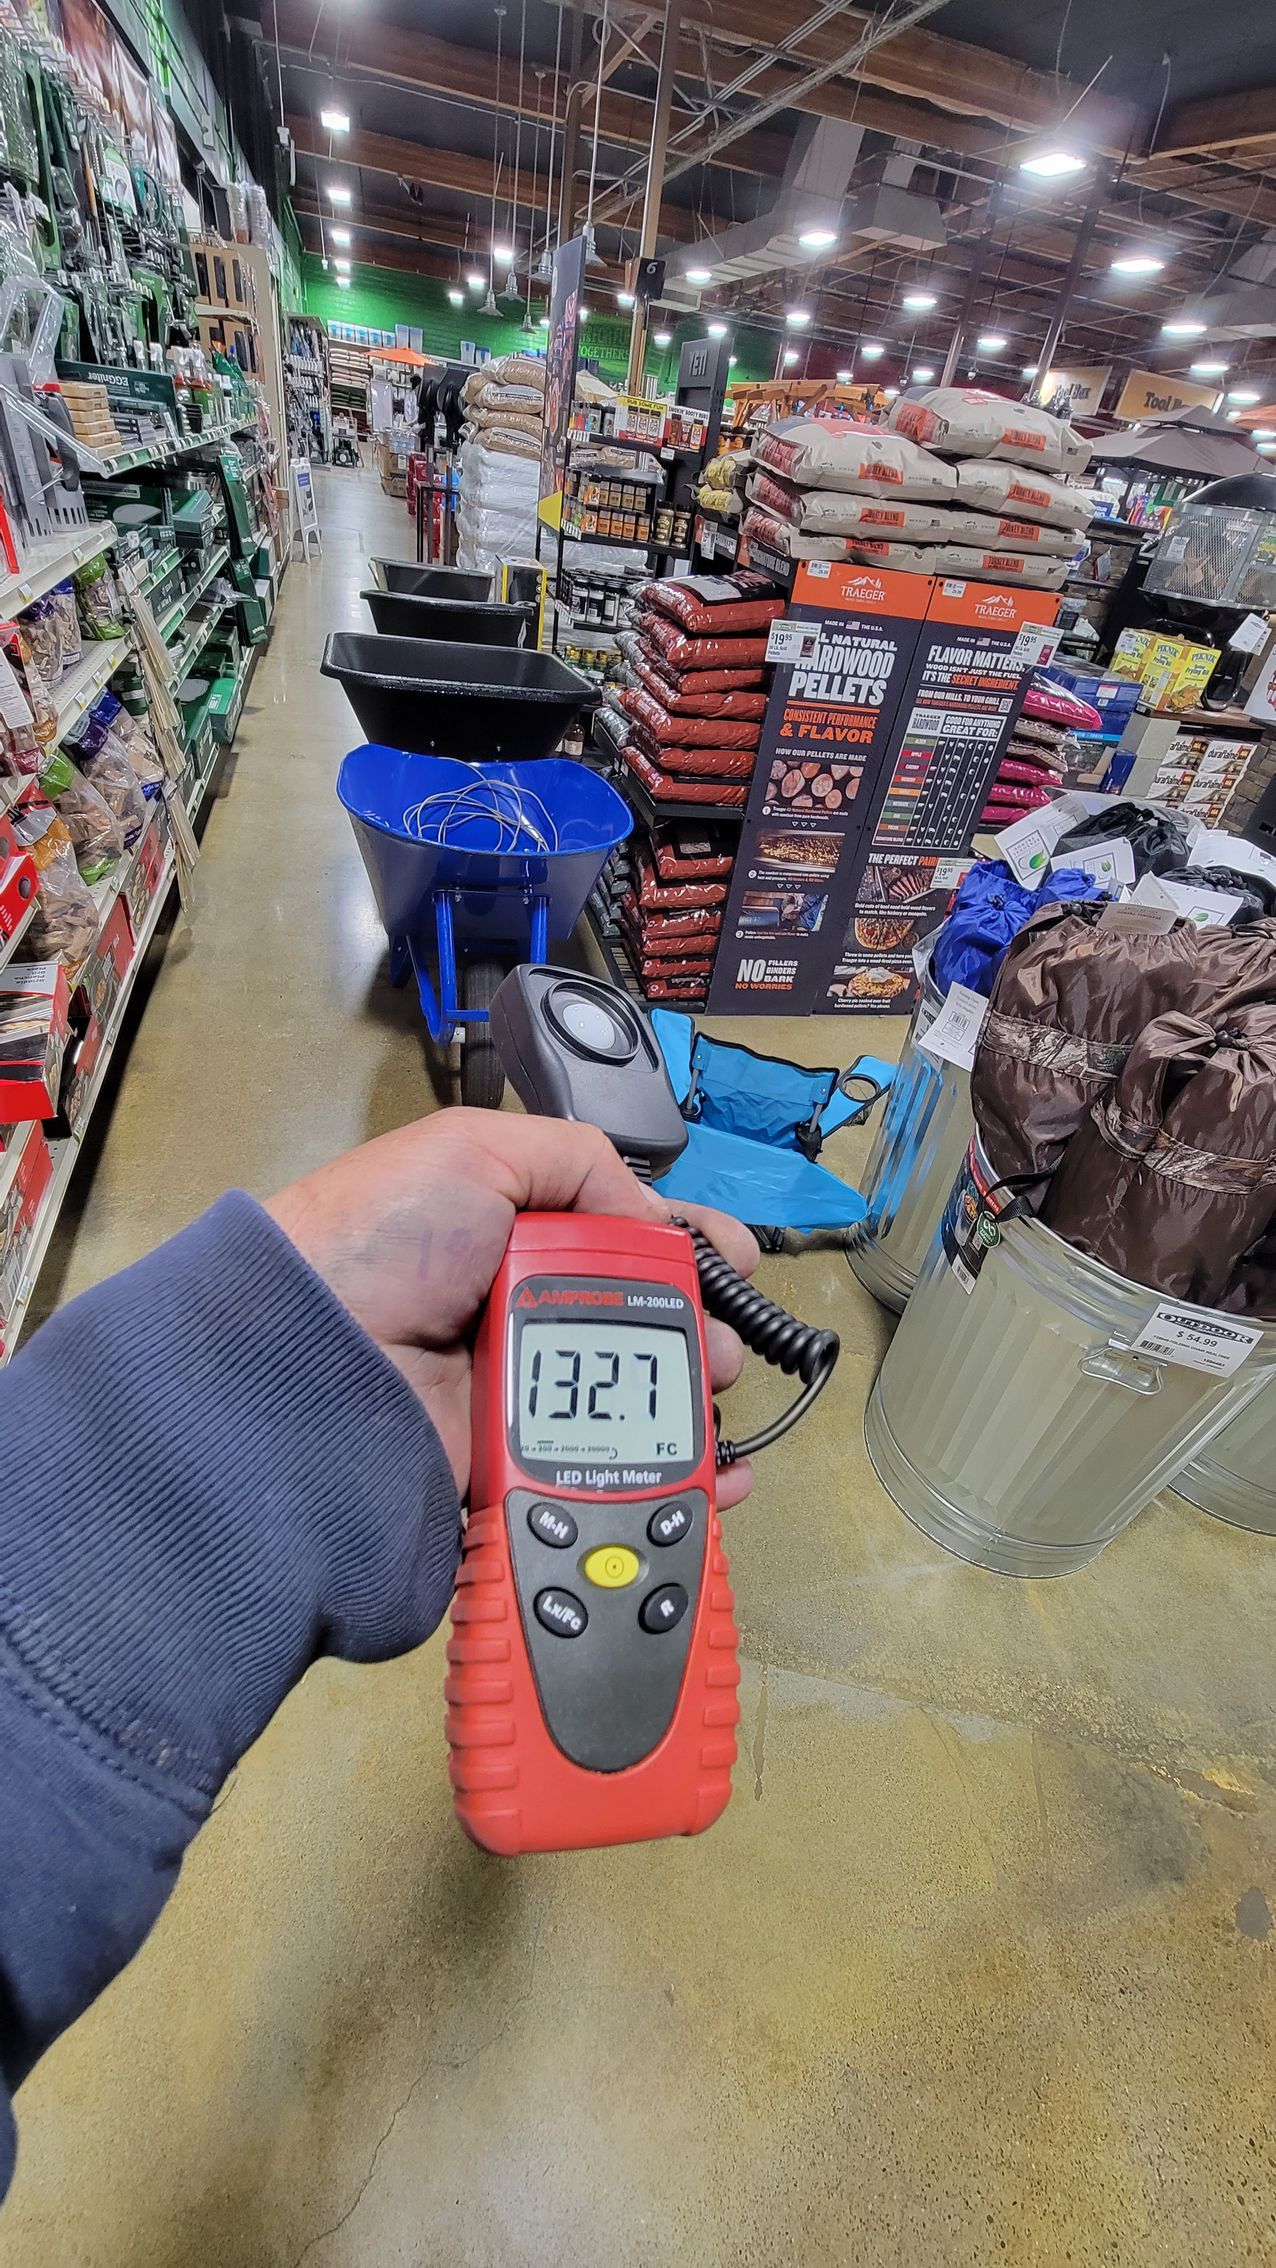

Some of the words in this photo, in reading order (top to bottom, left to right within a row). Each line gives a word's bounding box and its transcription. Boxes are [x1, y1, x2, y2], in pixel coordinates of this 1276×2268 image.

[646, 261, 658, 275] 6
[689, 349, 708, 377] YETI
[87, 371, 129, 387] EGGniter
[1144, 391, 1173, 411] Tool
[841, 585, 886, 601] TRAEGER
[974, 603, 1016, 619] TRAEGER
[831, 634, 898, 652] NATURAL
[927, 645, 973, 667] FLAVOR
[971, 650, 1026, 673] MATTERS.
[1191, 651, 1217, 664] PIKNIK
[922, 670, 937, 682] IT'S
[937, 672, 952, 684] THE
[950, 674, 979, 687] SECRET
[926, 663, 949, 672] WOOD
[949, 664, 968, 674] ISN'T
[968, 667, 988, 676] JUST
[988, 669, 1003, 678] THE
[788, 670, 888, 706] PELLETS
[917, 689, 934, 699] FROM
[933, 690, 946, 700] OUR
[963, 693, 971, 703] TO
[971, 694, 986, 704] YOUR
[984, 696, 1001, 706] GRILL
[783, 708, 829, 725] CONSISTENT
[827, 713, 878, 729] PERFORMANCE
[945, 716, 963, 725] GOOD
[961, 717, 974, 726] FOR
[973, 718, 1001, 729] ANYTHING
[780, 722, 794, 738] &
[798, 724, 874, 744] FLAVOR
[942, 724, 976, 736] GREAT
[975, 727, 998, 738] FOR:
[775, 747, 791, 756] HOW
[791, 748, 806, 757] OUR
[806, 750, 834, 760] PELLETS
[834, 752, 848, 760] ARE
[847, 753, 867, 762] MADE
[1207, 748, 1239, 760] duraflame
[1192, 778, 1223, 789] duraflame
[868, 852, 885, 864] THE
[883, 853, 919, 866] PERFECT
[918, 855, 938, 867] PAIR
[736, 958, 766, 984] NO
[765, 966, 797, 975] BINDERS
[767, 959, 799, 967] FILLERS
[748, 983, 793, 991] WORRIES
[763, 975, 795, 984] BARK
[538, 1289, 624, 1307] AMPROBE
[627, 1295, 685, 1310] LM-200LED
[1160, 1313, 1252, 1345] OUTDOOR
[1176, 1330, 1185, 1339] $
[1185, 1333, 1218, 1348] 54.99
[528, 1350, 658, 1421] 132.7
[656, 1442, 678, 1456] FC
[555, 1470, 582, 1486] LED
[585, 1470, 620, 1488] Light
[622, 1470, 663, 1486] Meter
[659, 1510, 686, 1537] D-H
[542, 1595, 583, 1631] Lx/Fc
[659, 1599, 675, 1617] R
